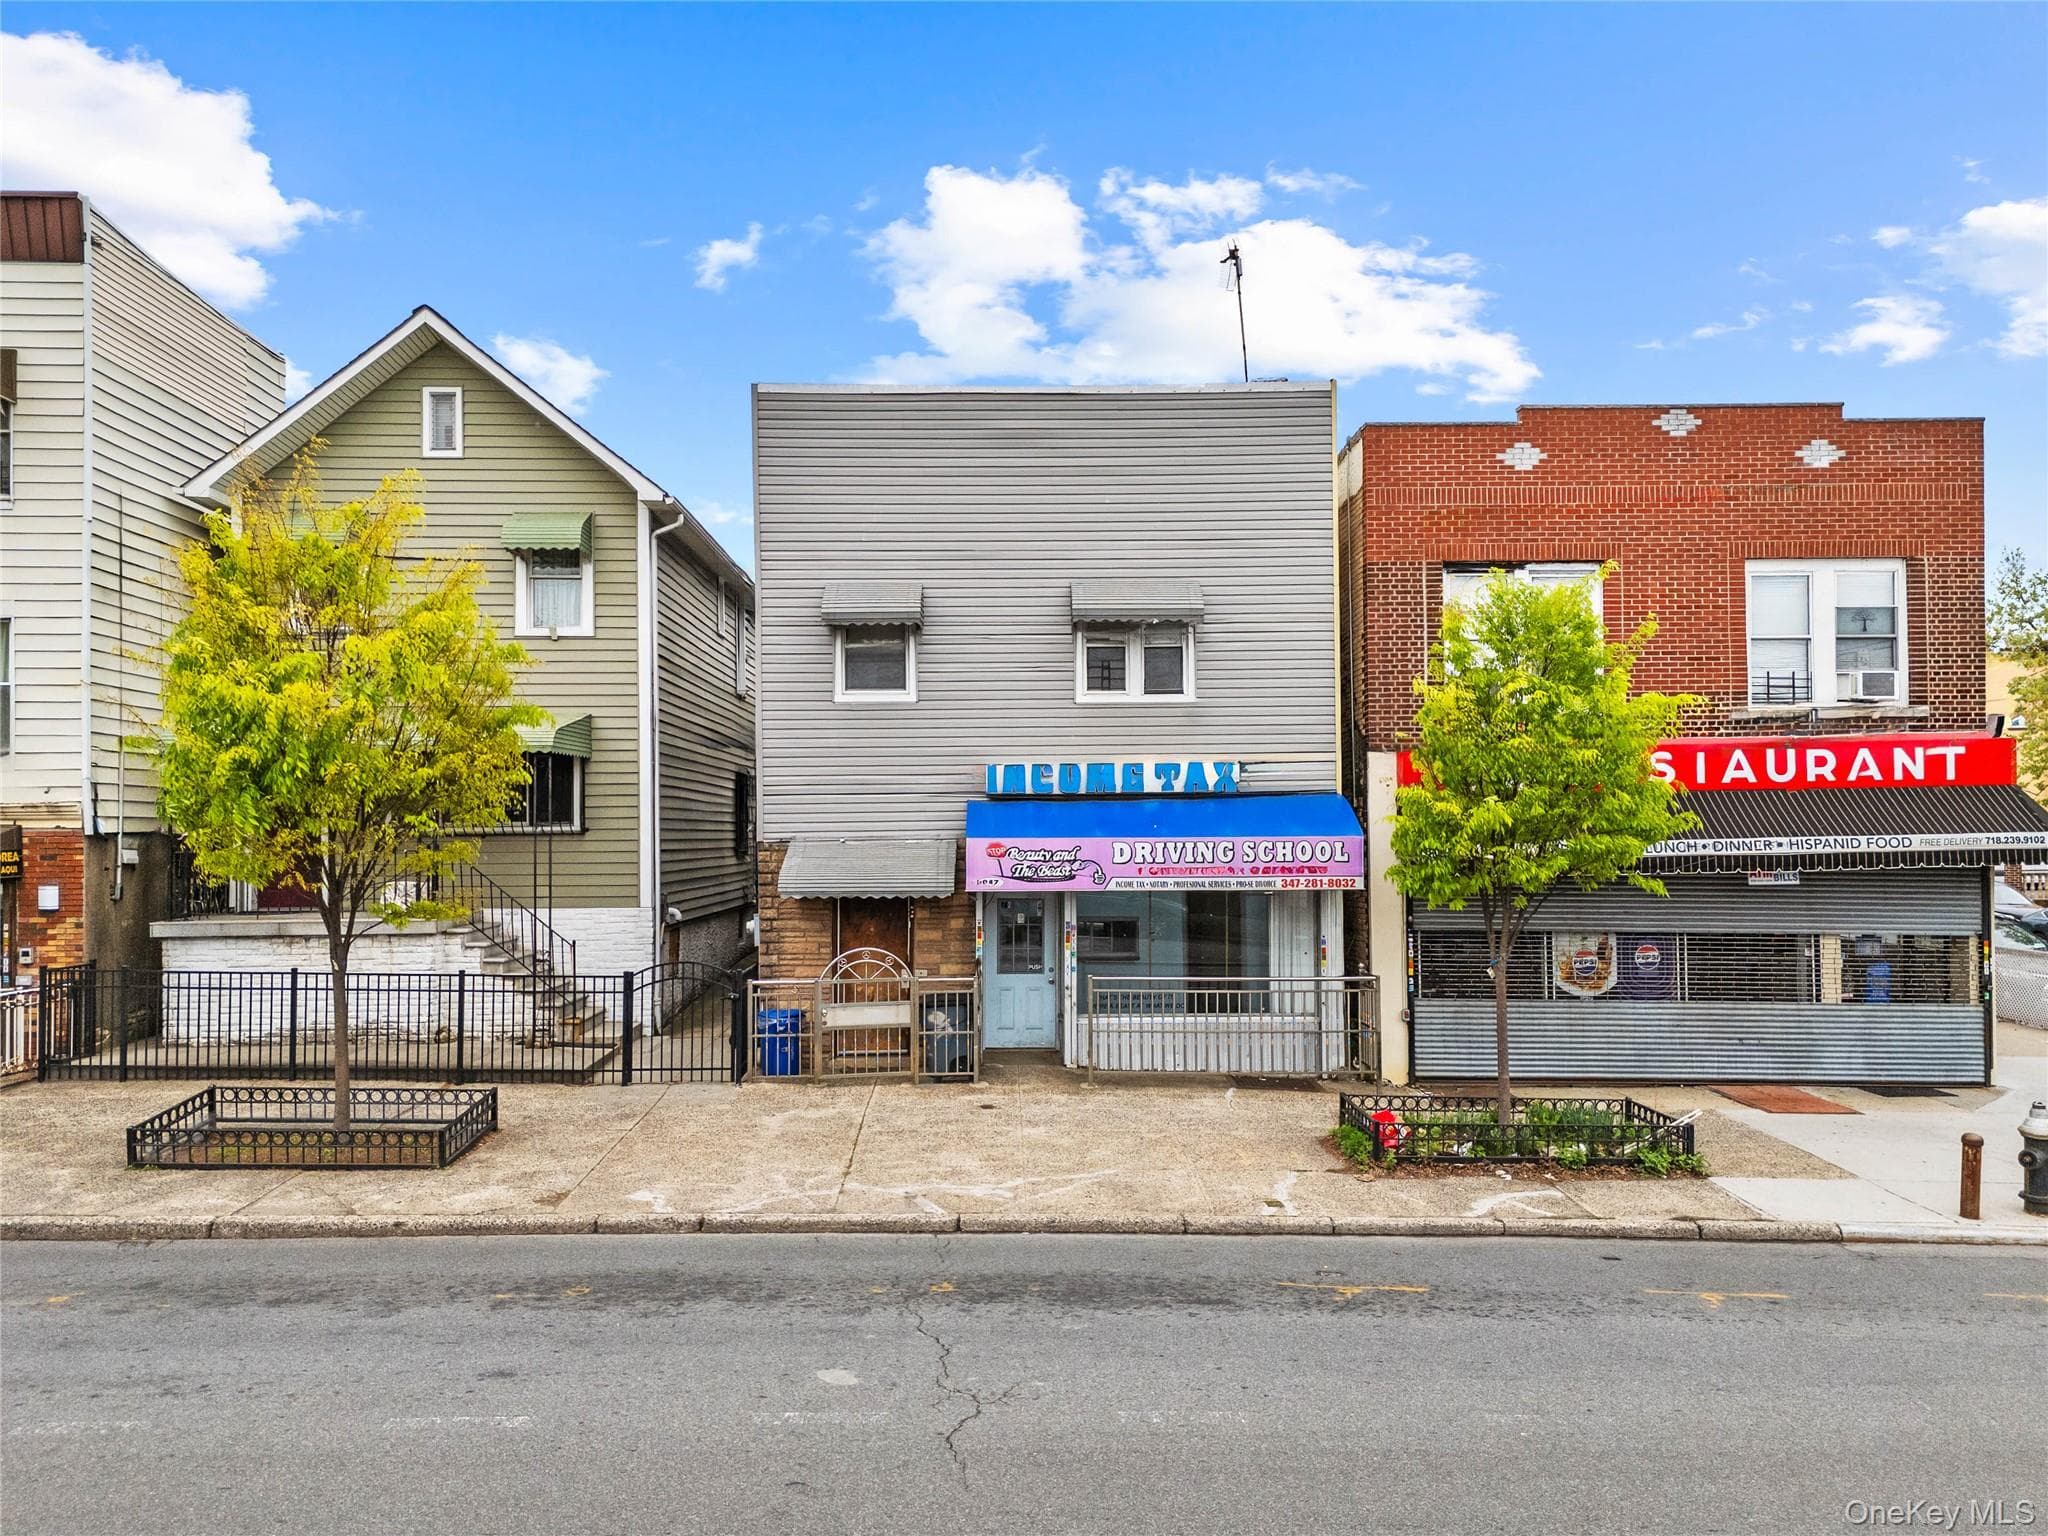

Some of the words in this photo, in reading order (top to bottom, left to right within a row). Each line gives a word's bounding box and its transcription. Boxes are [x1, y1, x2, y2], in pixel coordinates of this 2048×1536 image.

[986, 762, 1144, 794] INCOME
[1154, 761, 1239, 793] TAX
[1713, 840, 1773, 852] DINNER
[1789, 838, 1861, 850] HISPANID
[1867, 836, 1912, 849] FOOD
[1919, 839, 1942, 847] FREE
[1944, 837, 1983, 846] DELIVERY
[1985, 835, 2046, 845] 718.239.9102
[0, 851, 20, 862] REA
[987, 847, 1007, 856] STOP
[1006, 847, 1051, 862] Beauty
[1052, 845, 1082, 860] and
[1112, 841, 1235, 864] DRIVING
[1242, 840, 1350, 863] SCHOOL
[1011, 863, 1035, 878] The
[1037, 863, 1073, 878] Beast
[1773, 872, 1799, 881] BILLS
[1115, 880, 1134, 889] INCOME
[1136, 880, 1145, 888] TAX
[1149, 880, 1169, 888] NOTARY
[1208, 880, 1231, 888] SERVICES
[1236, 880, 1253, 888] PRO-SE
[1255, 879, 1276, 888] DIVORCE
[1281, 878, 1356, 888] 347-281-8032
